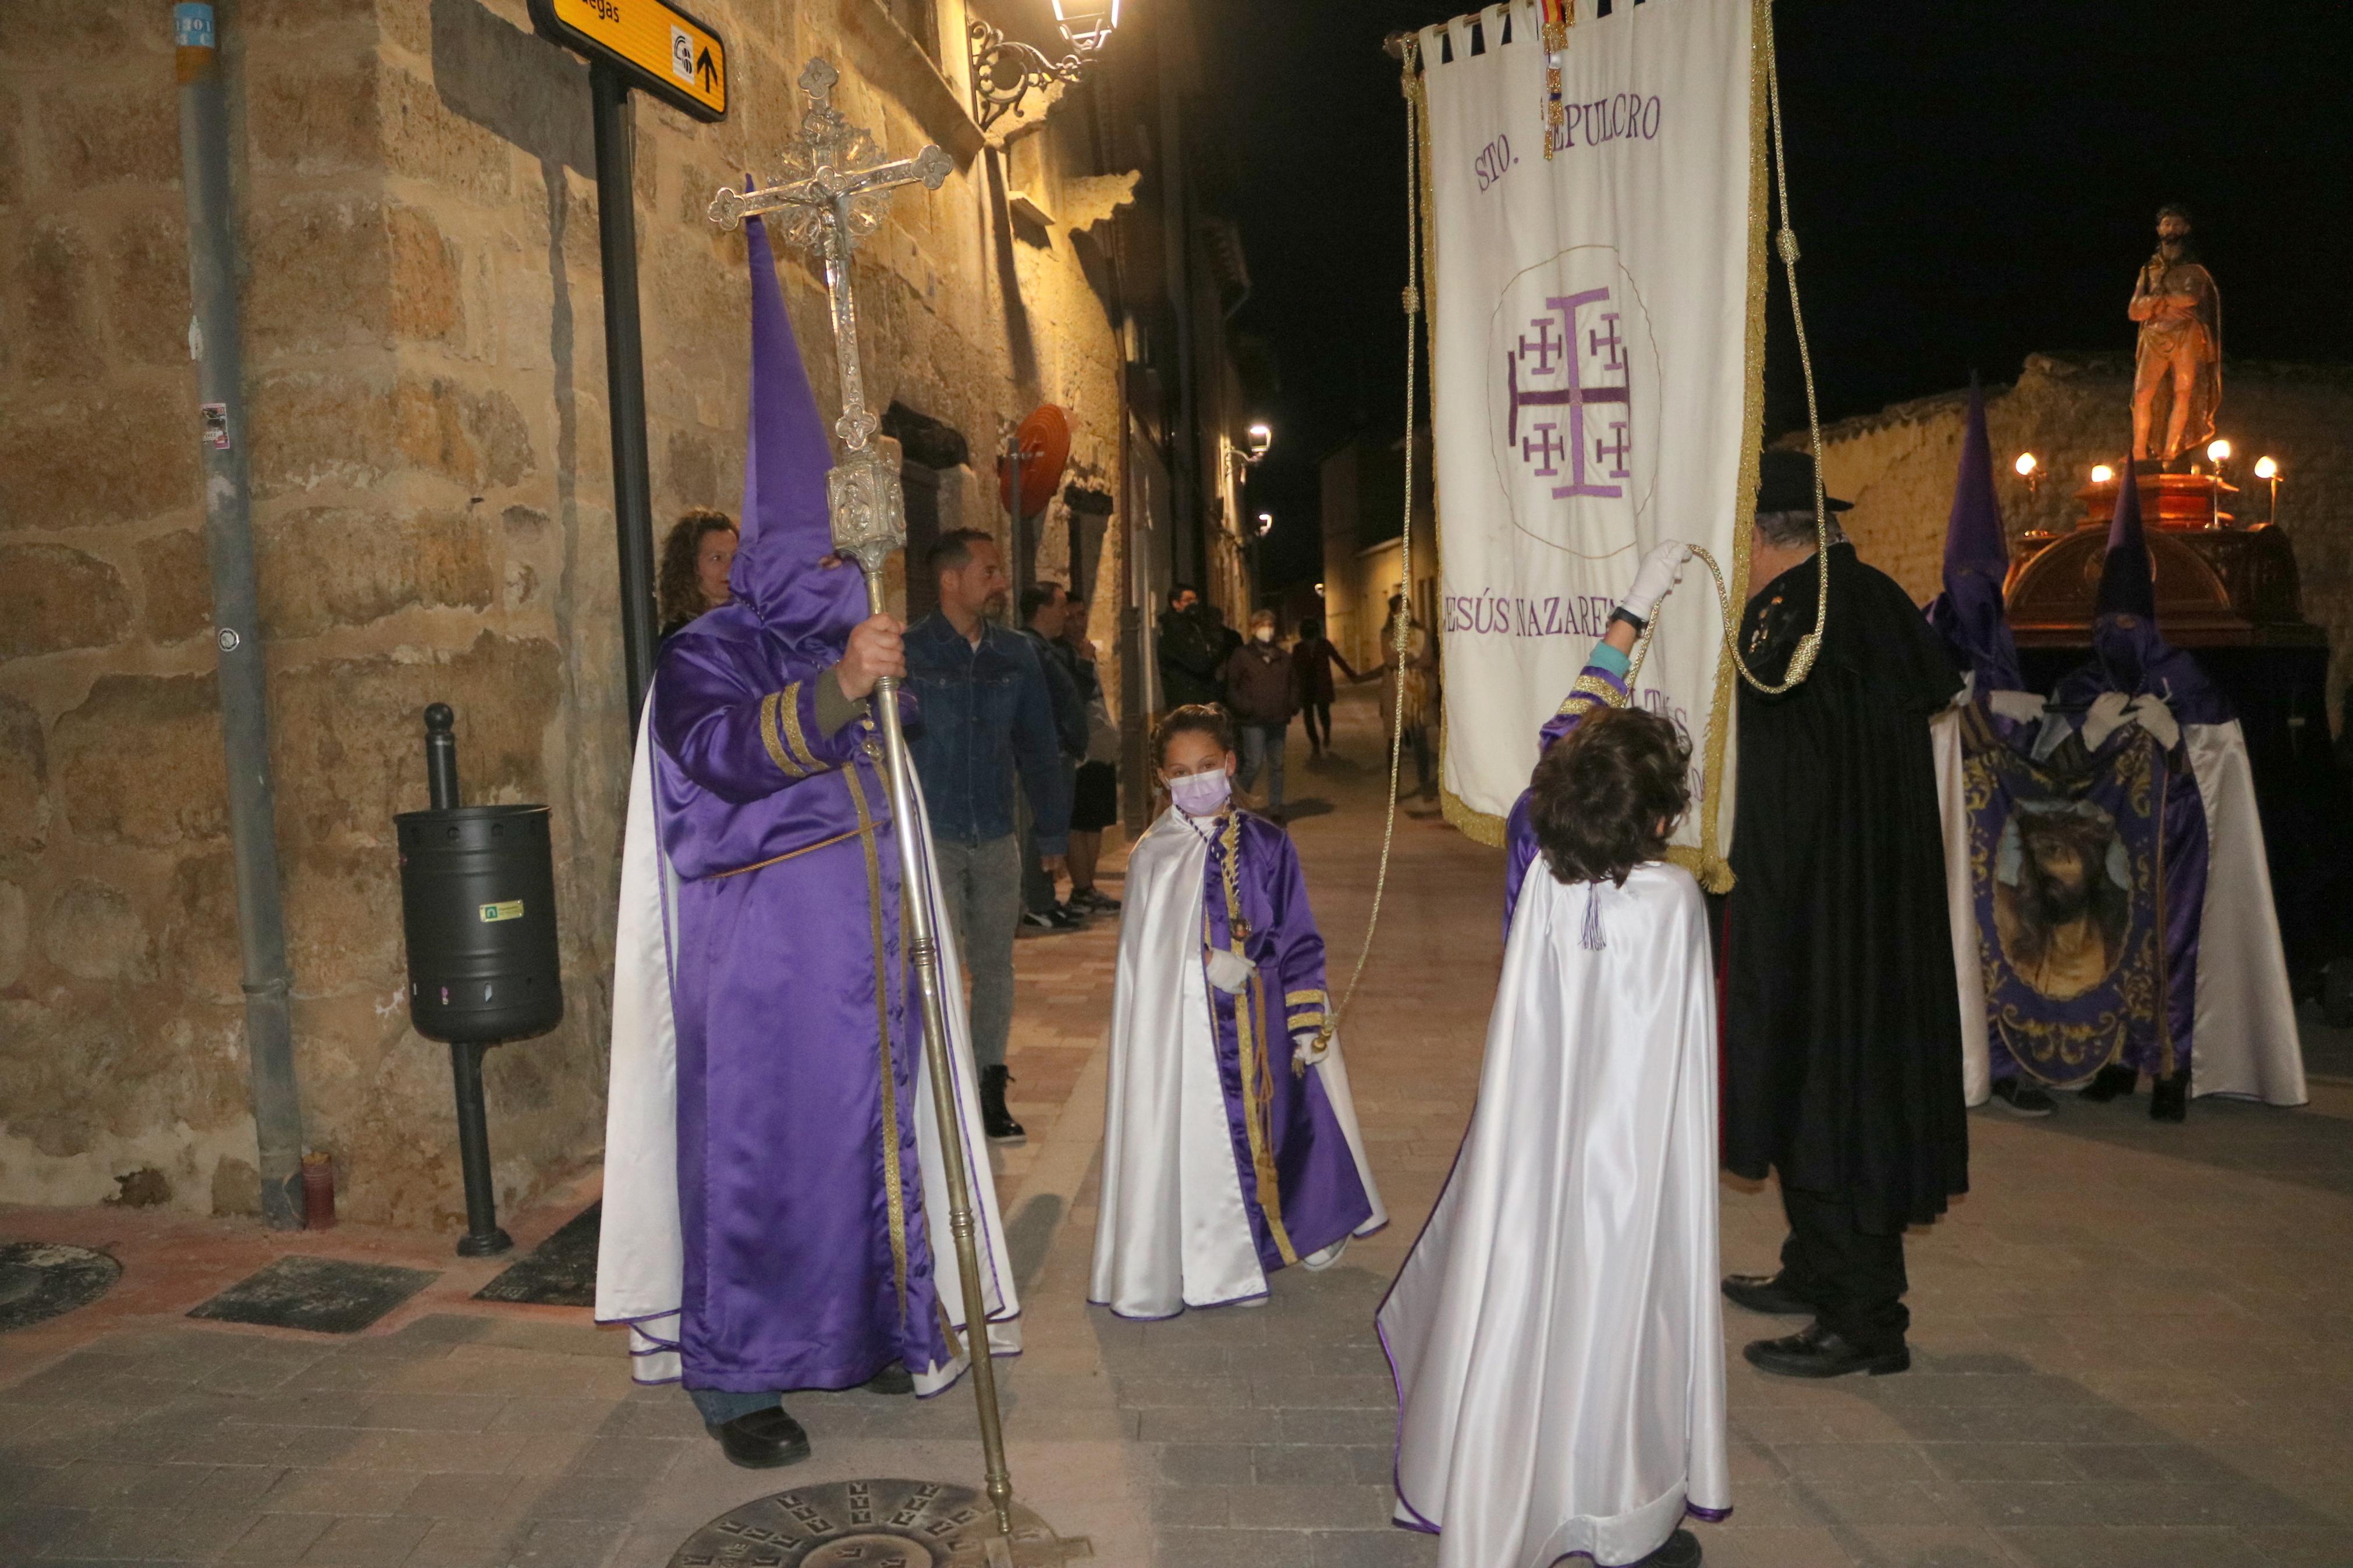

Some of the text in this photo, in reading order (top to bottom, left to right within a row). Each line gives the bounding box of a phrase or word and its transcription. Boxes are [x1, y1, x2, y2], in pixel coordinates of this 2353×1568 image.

[583, 0, 619, 23] egas
[1475, 93, 1660, 195] STO. EPULCRO
